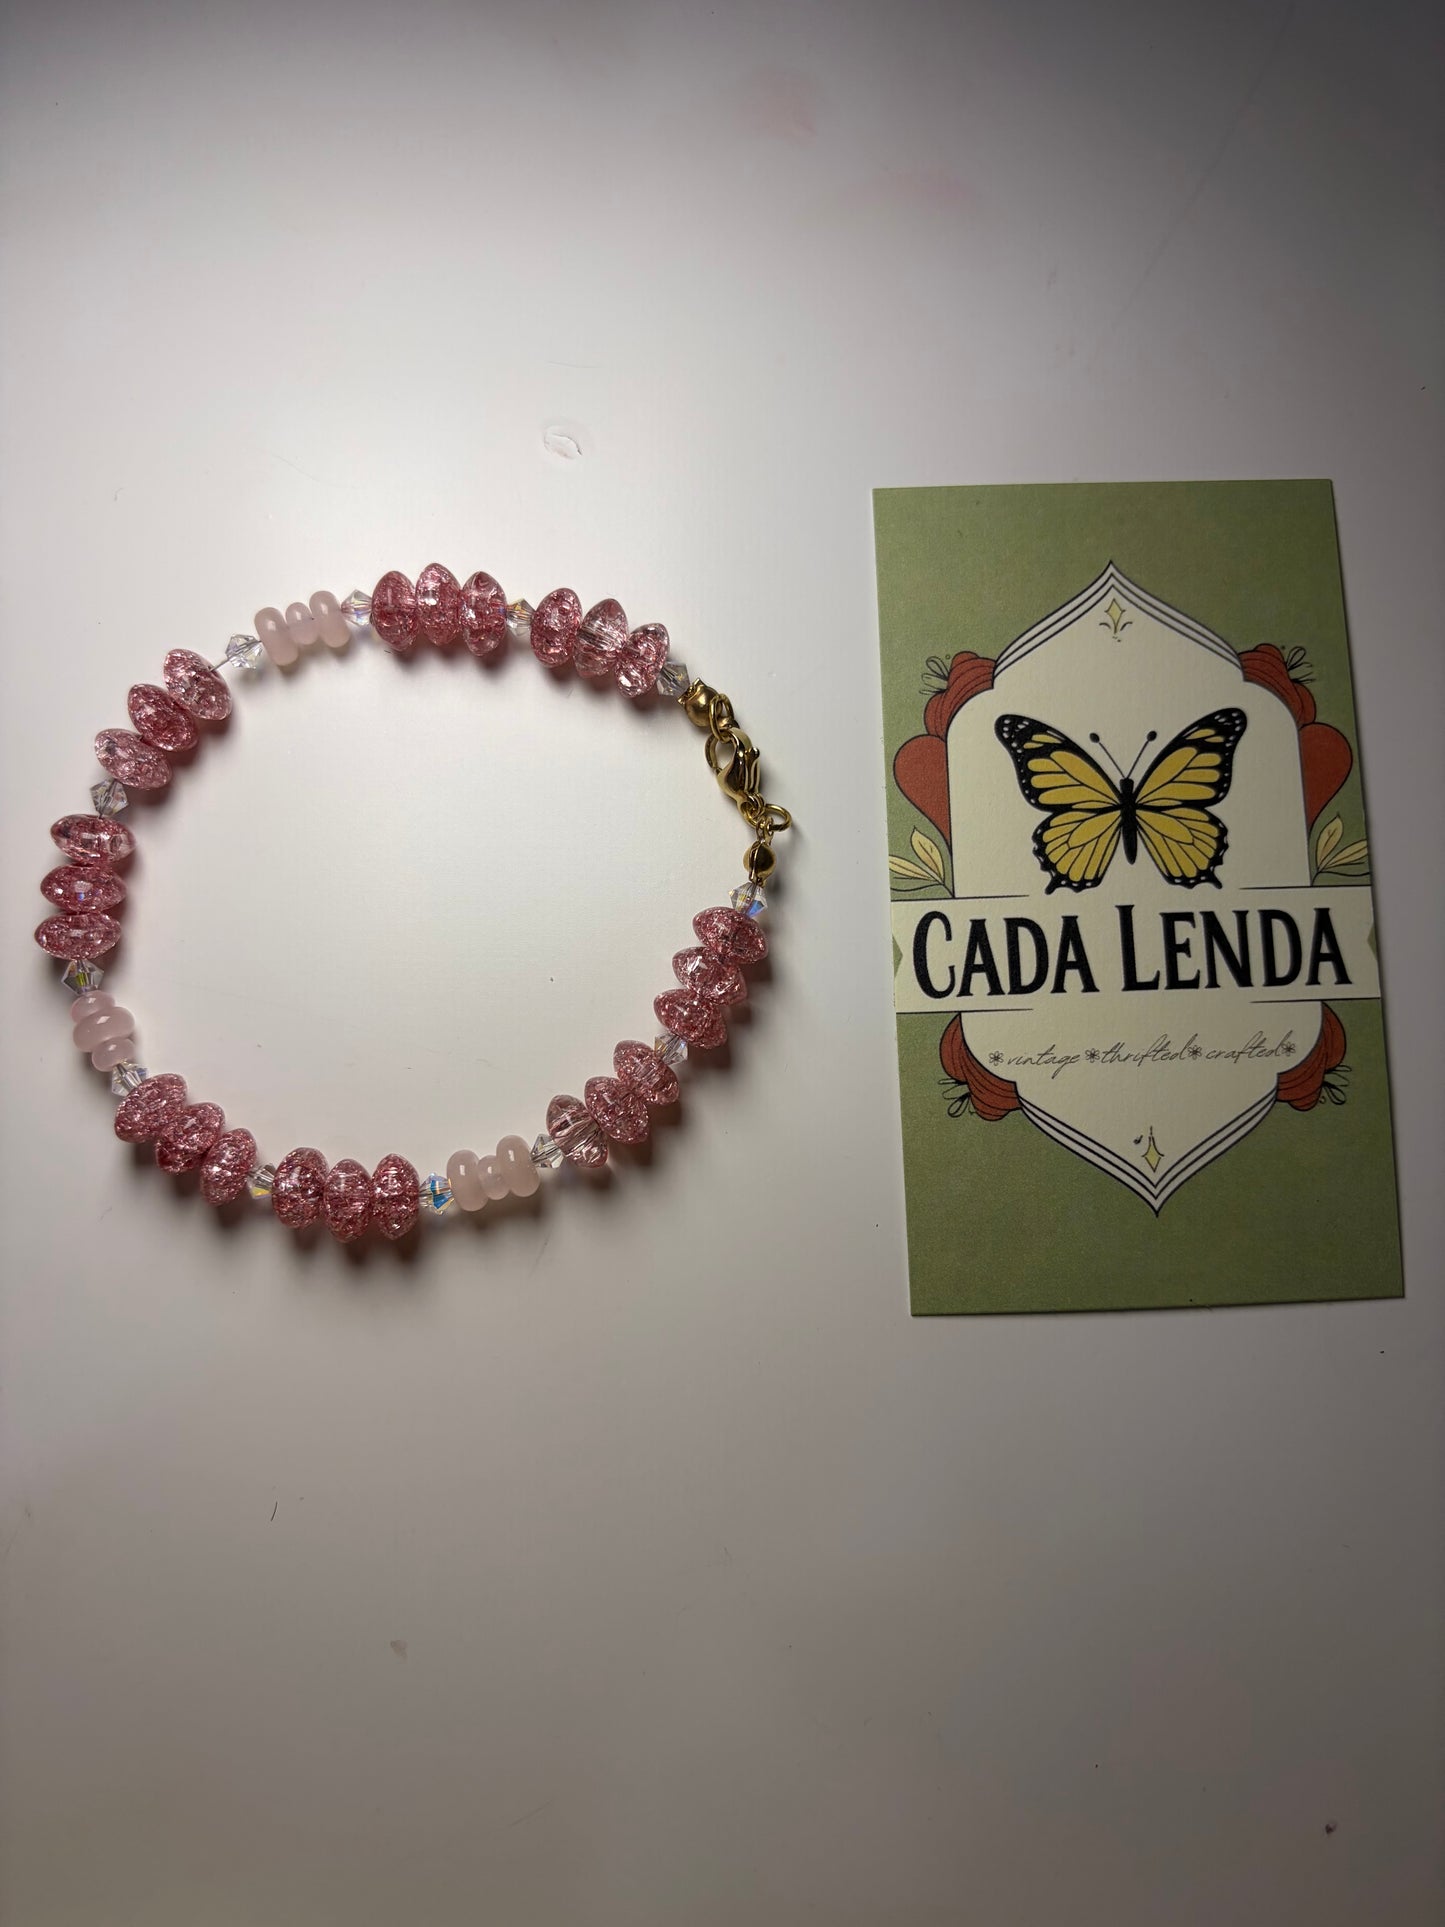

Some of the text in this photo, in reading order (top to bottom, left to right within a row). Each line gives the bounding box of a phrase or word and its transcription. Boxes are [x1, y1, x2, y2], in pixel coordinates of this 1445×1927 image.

[912, 904, 1352, 999] CADA LENDA
[1007, 1030, 1293, 1079] vintage thrifted crafted
